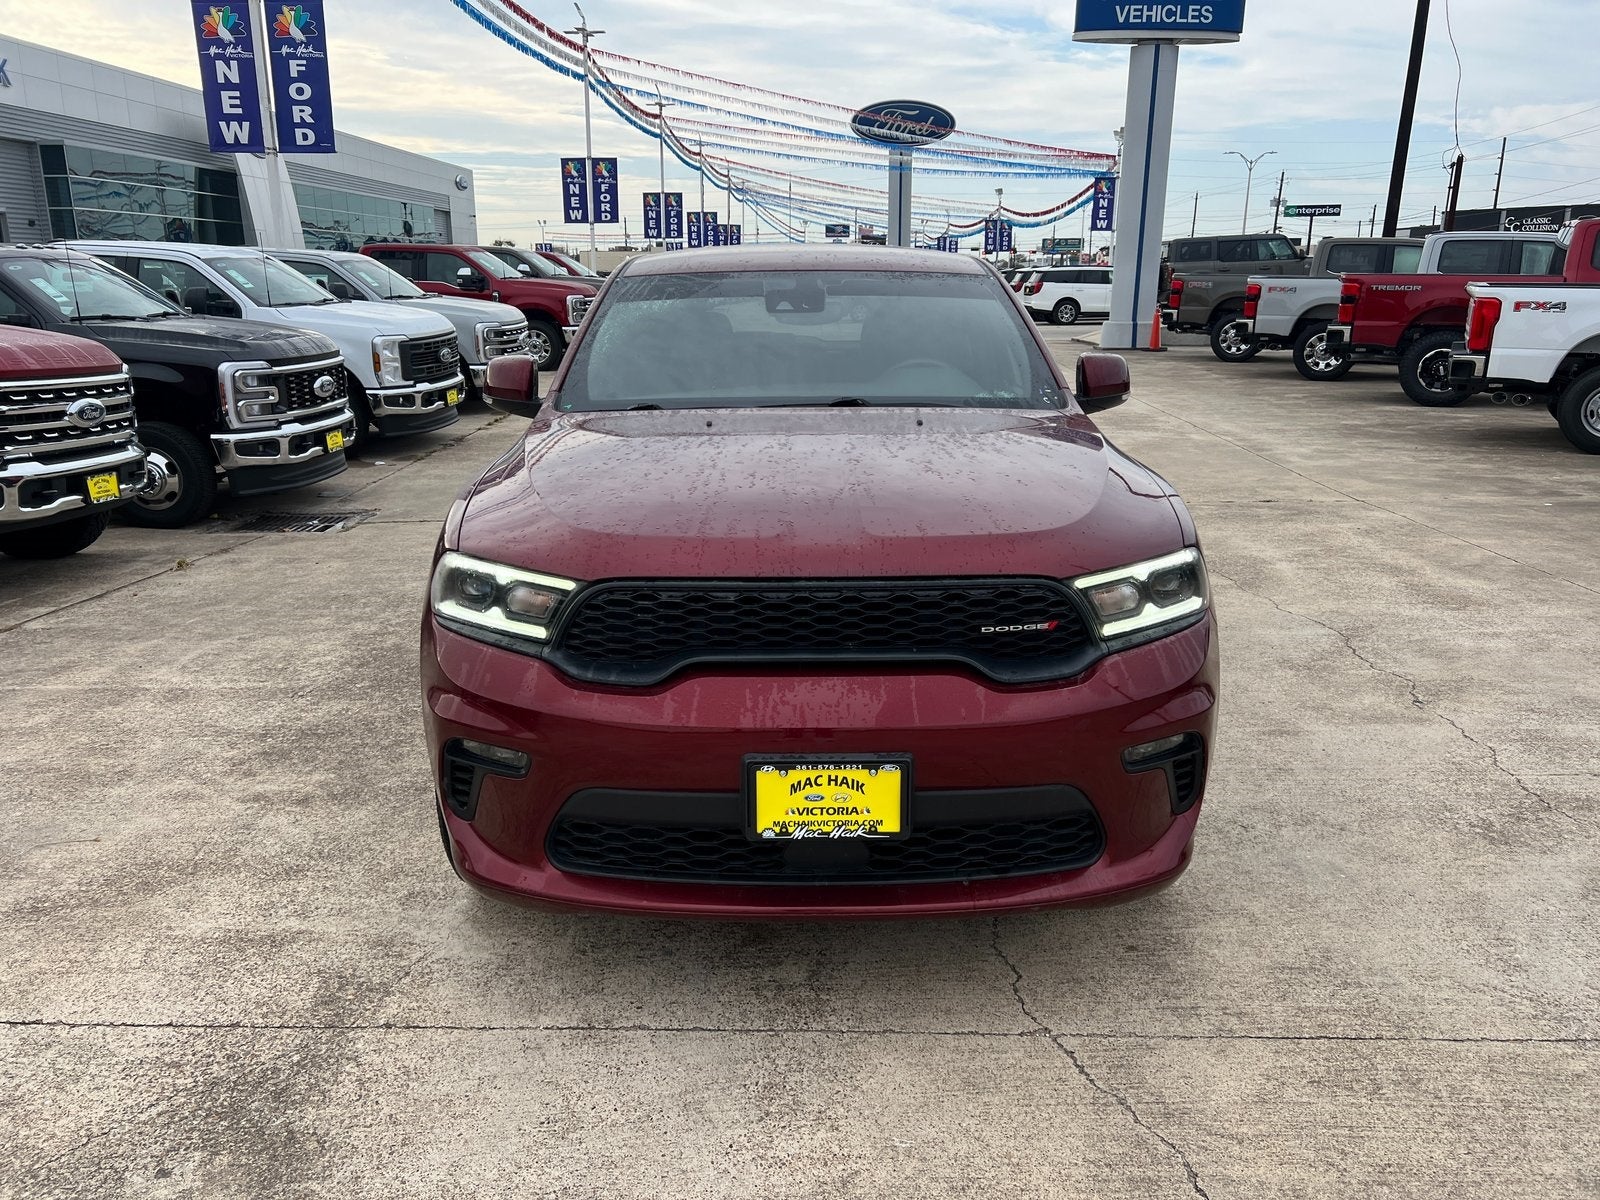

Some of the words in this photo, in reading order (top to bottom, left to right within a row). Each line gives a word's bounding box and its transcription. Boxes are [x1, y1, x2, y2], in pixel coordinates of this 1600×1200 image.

[1115, 5, 1213, 23] VEHICLES
[215, 60, 250, 144] NEW
[288, 59, 316, 146] FORD
[874, 108, 935, 137] Ford
[569, 183, 583, 220] NEW
[600, 183, 611, 221] FORD
[1288, 206, 1340, 215] enterprise
[1096, 198, 1108, 229] NEW
[1522, 217, 1552, 225] CLASSIC
[648, 211, 658, 237] NEW
[670, 211, 678, 237] FORD
[691, 225, 699, 246] NEW
[987, 232, 995, 251] NEW
[1513, 301, 1567, 312] FX4
[82, 406, 100, 419] Ford
[981, 622, 1049, 633] DODGE
[789, 774, 824, 796] MAC
[827, 774, 866, 796] HAIK
[796, 806, 860, 816] VICTORIA
[772, 819, 884, 828] MACHAIKVICTORIA.COM
[790, 825, 823, 840] Mac
[828, 825, 869, 839] Haik
